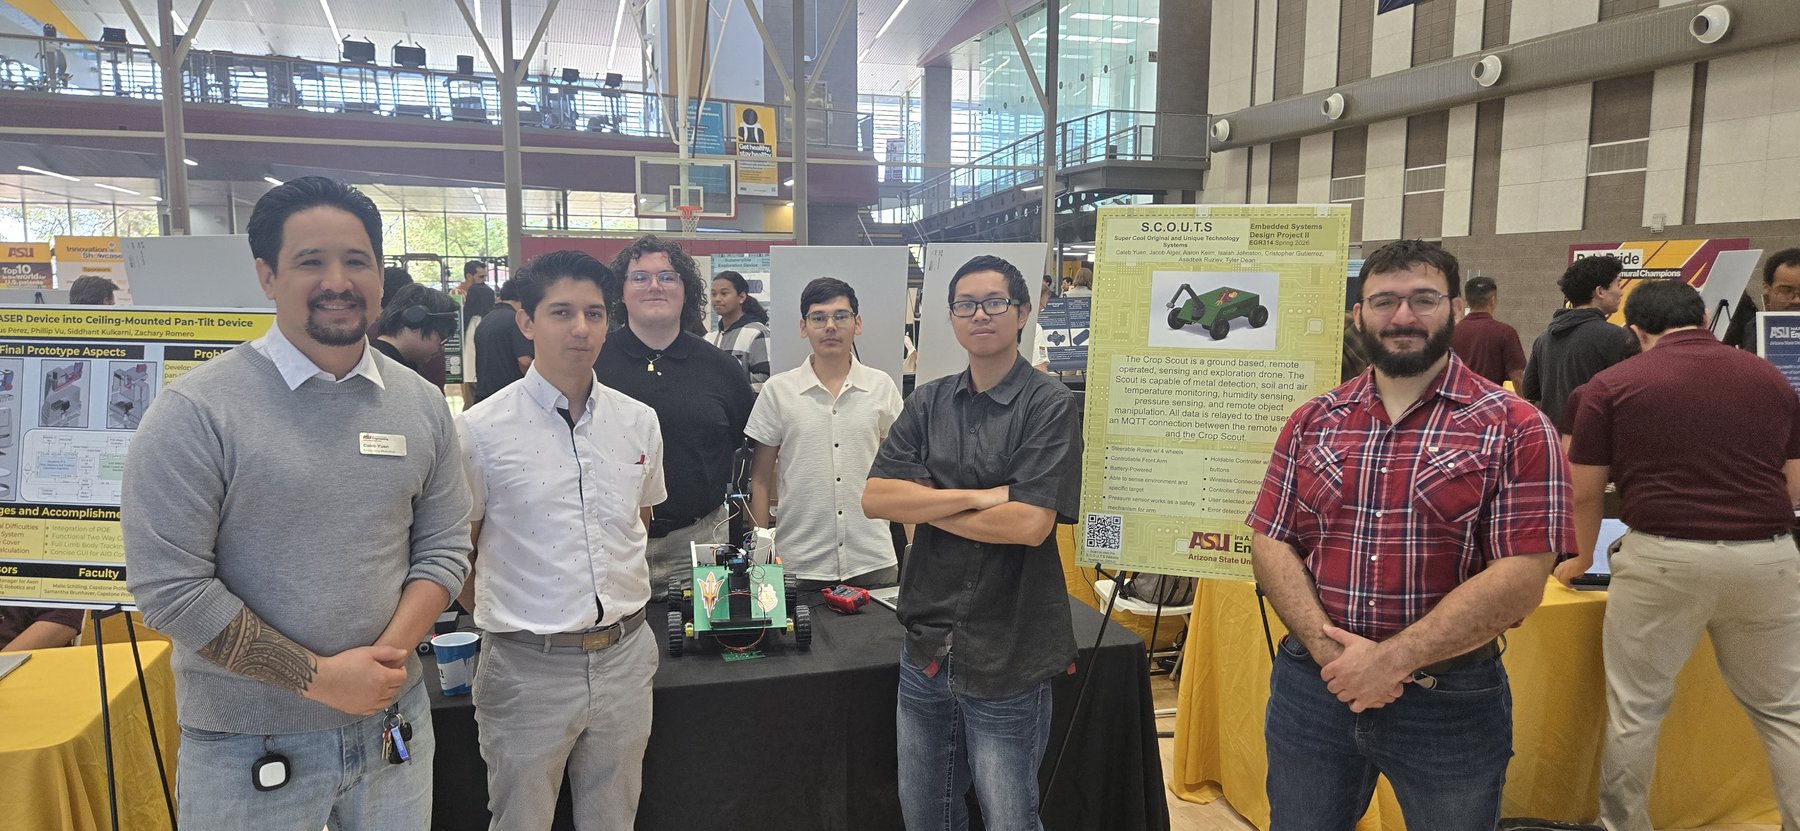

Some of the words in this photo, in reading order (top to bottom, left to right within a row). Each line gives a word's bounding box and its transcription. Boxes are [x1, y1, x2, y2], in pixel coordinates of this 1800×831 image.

[1141, 222, 1213, 232] S.C.O.U.T.S
[1249, 231, 1275, 239] Design
[1276, 232, 1304, 240] Project
[1274, 240, 1293, 248] Spring
[8, 247, 34, 258] ASU
[1640, 269, 1681, 279] Champions
[26, 314, 60, 324] Device
[62, 314, 83, 324] into
[85, 315, 171, 327] Ceiling-Mounted
[174, 317, 215, 327] Pan-Tilt
[217, 318, 253, 328] Device
[8, 327, 30, 335] Perez,
[31, 327, 53, 336] Phillip
[54, 328, 66, 336] Vu,
[67, 328, 99, 336] Siddhant
[101, 328, 133, 338] Kulkarni,
[134, 329, 164, 339] Zachary
[165, 330, 195, 338] Romero
[1769, 326, 1790, 339] ASU
[0, 344, 25, 355] Final
[27, 345, 80, 357] Prototype
[82, 346, 127, 358] Aspects
[1126, 355, 1141, 363] The
[1143, 355, 1162, 365] Crop
[1165, 356, 1188, 364] Scout
[1190, 357, 1197, 365] is
[1207, 358, 1236, 367] ground
[1238, 359, 1267, 368] based,
[1269, 361, 1300, 369] remote
[1118, 366, 1157, 375] operated,
[1159, 367, 1190, 376] sensing
[1192, 368, 1208, 376] and
[1210, 369, 1256, 378] exploration
[1258, 370, 1285, 379] drone.
[1288, 371, 1305, 380] The
[1115, 375, 1138, 384] Scout
[1140, 376, 1147, 384] is
[1149, 377, 1181, 386] capable
[1182, 377, 1192, 386] of
[1193, 379, 1216, 387] metal
[1217, 379, 1258, 389] detection,
[1261, 381, 1276, 389] soil
[1278, 382, 1294, 390] and
[1296, 382, 1308, 390] air
[1124, 386, 1173, 395] temperature
[1174, 388, 1220, 399] monitoring,
[1222, 390, 1258, 400] humidity
[1260, 392, 1296, 402] sensing,
[1134, 398, 1169, 406] pressure
[1172, 399, 1206, 409] sensing,
[1258, 402, 1284, 412] object
[1114, 407, 1167, 416] manipulation.
[1169, 408, 1179, 416] All
[1181, 409, 1200, 417] data
[1202, 410, 1209, 418] is
[1211, 411, 1242, 421] relayed
[1244, 412, 1252, 420] to
[1254, 412, 1268, 421] the
[1121, 416, 1147, 426] MQTT
[1148, 418, 1192, 427] connection
[1194, 420, 1230, 429] between
[1232, 422, 1245, 430] the
[1247, 424, 1277, 432] remote
[1165, 430, 1181, 438] and
[1182, 430, 1196, 438] the
[1197, 431, 1219, 441] Crop
[1220, 432, 1247, 441] Scout.
[1235, 457, 1262, 465] Controller
[1110, 465, 1152, 473] Battery-Powered
[18, 506, 39, 516] and
[5, 522, 39, 530] Difficulties
[52, 525, 87, 533] Integration
[51, 532, 86, 540] Functional
[1189, 531, 1230, 552] ASU
[82, 542, 98, 550] Body
[1234, 541, 1251, 553] En
[1188, 553, 1217, 562] Arizona
[1218, 555, 1239, 564] State
[1240, 557, 1251, 565] Un
[78, 567, 119, 580] Faculty
